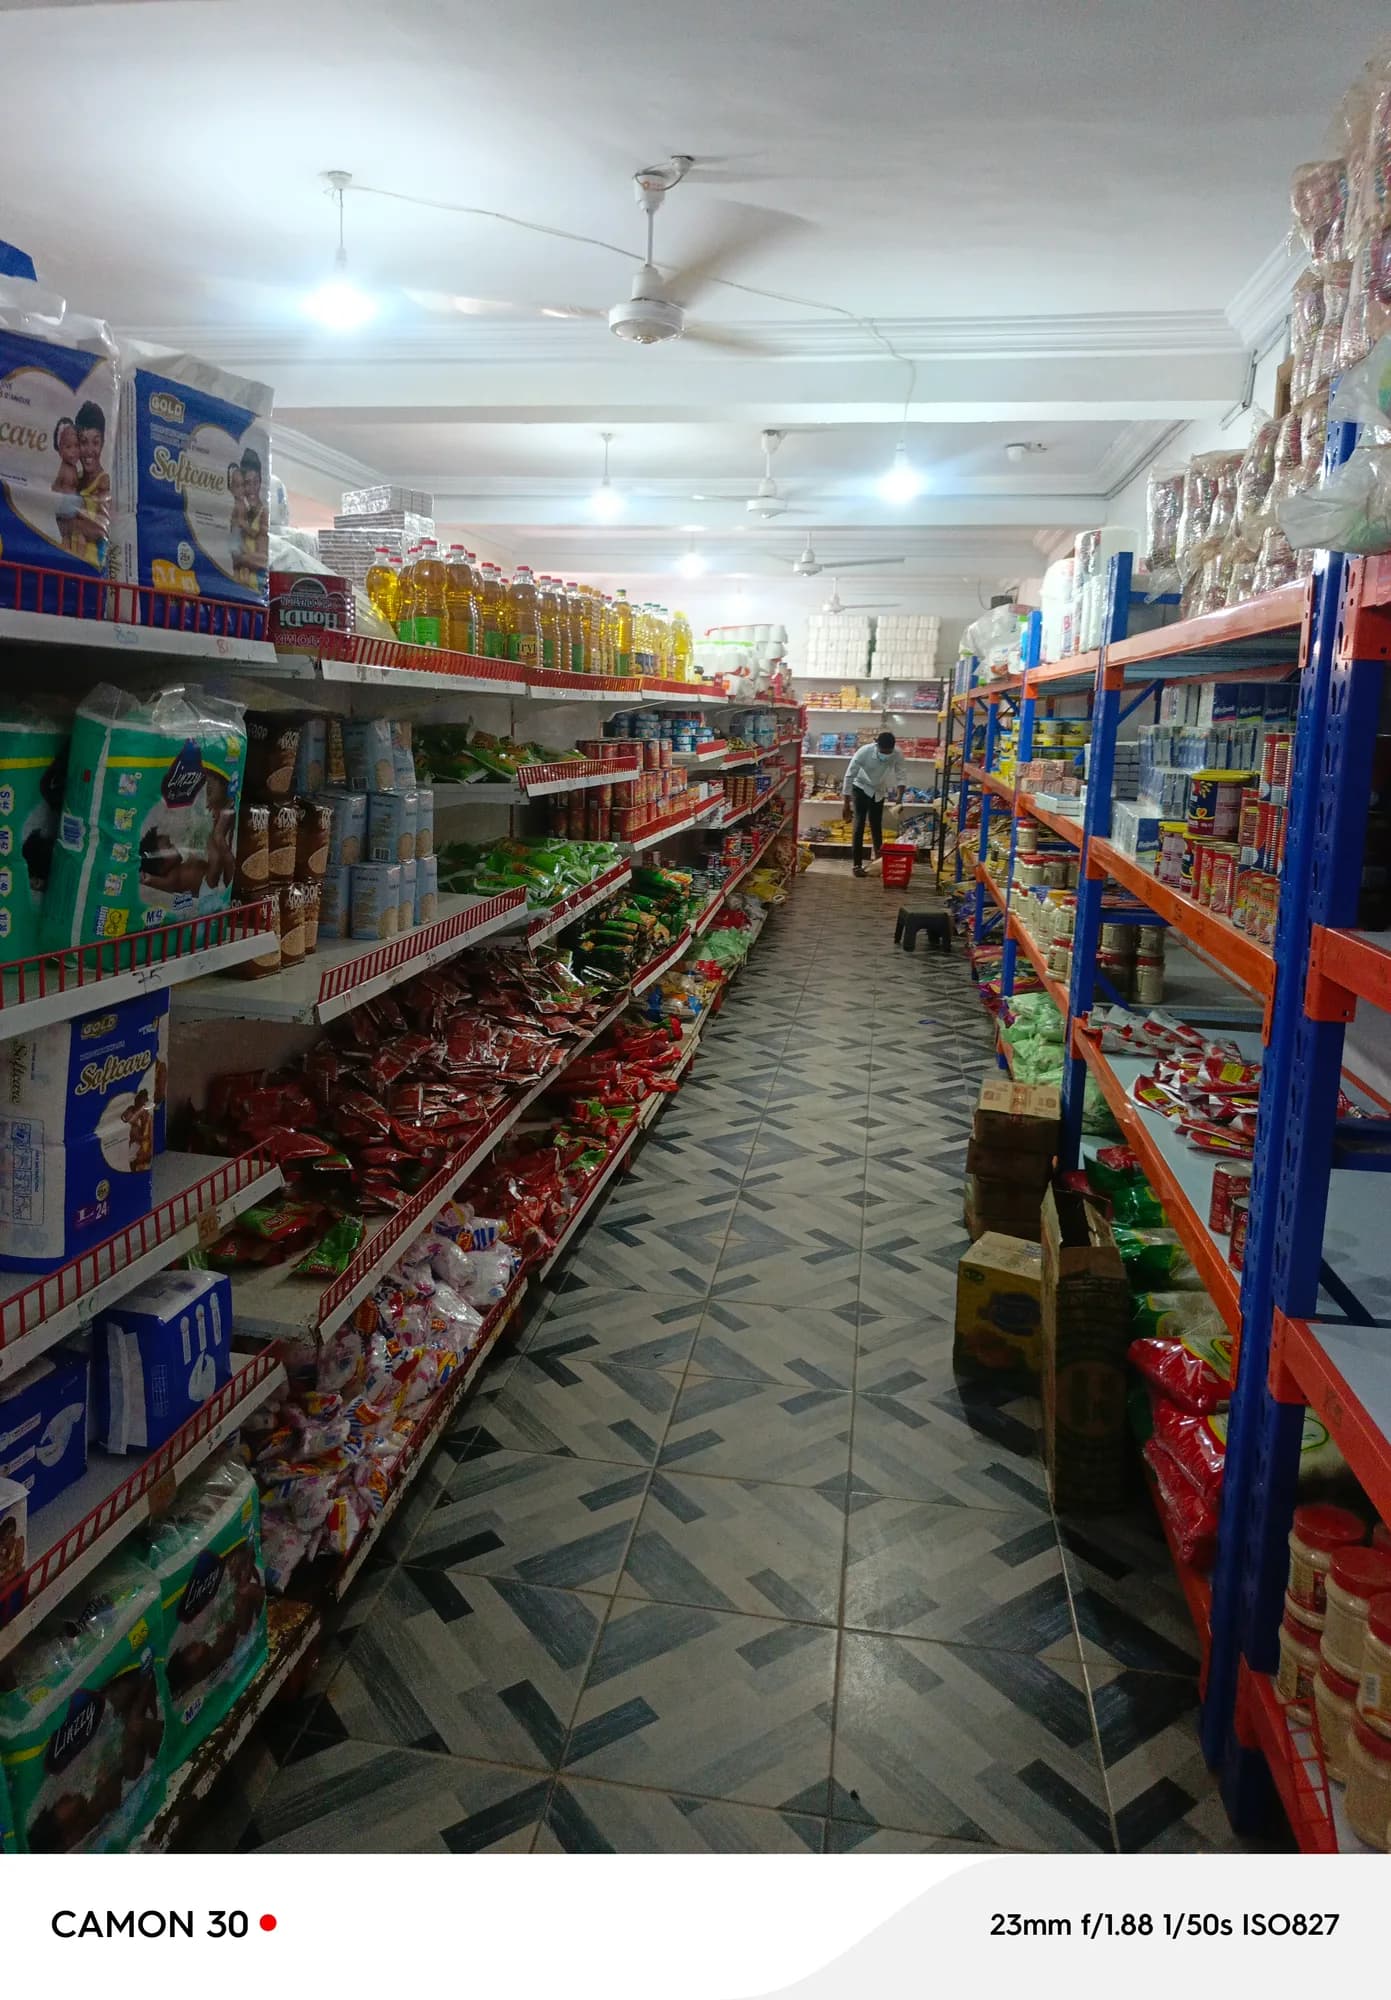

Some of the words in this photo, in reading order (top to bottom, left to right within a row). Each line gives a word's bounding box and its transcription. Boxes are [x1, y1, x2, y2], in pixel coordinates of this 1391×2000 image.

[151, 396, 184, 416] GOLD
[149, 446, 225, 494] Softcare
[279, 608, 339, 631] HonDi
[167, 760, 202, 797] Linzzy
[83, 1014, 118, 1037] GOLD
[75, 1050, 151, 1095] Softcare
[53, 1700, 97, 1759] Linzzy
